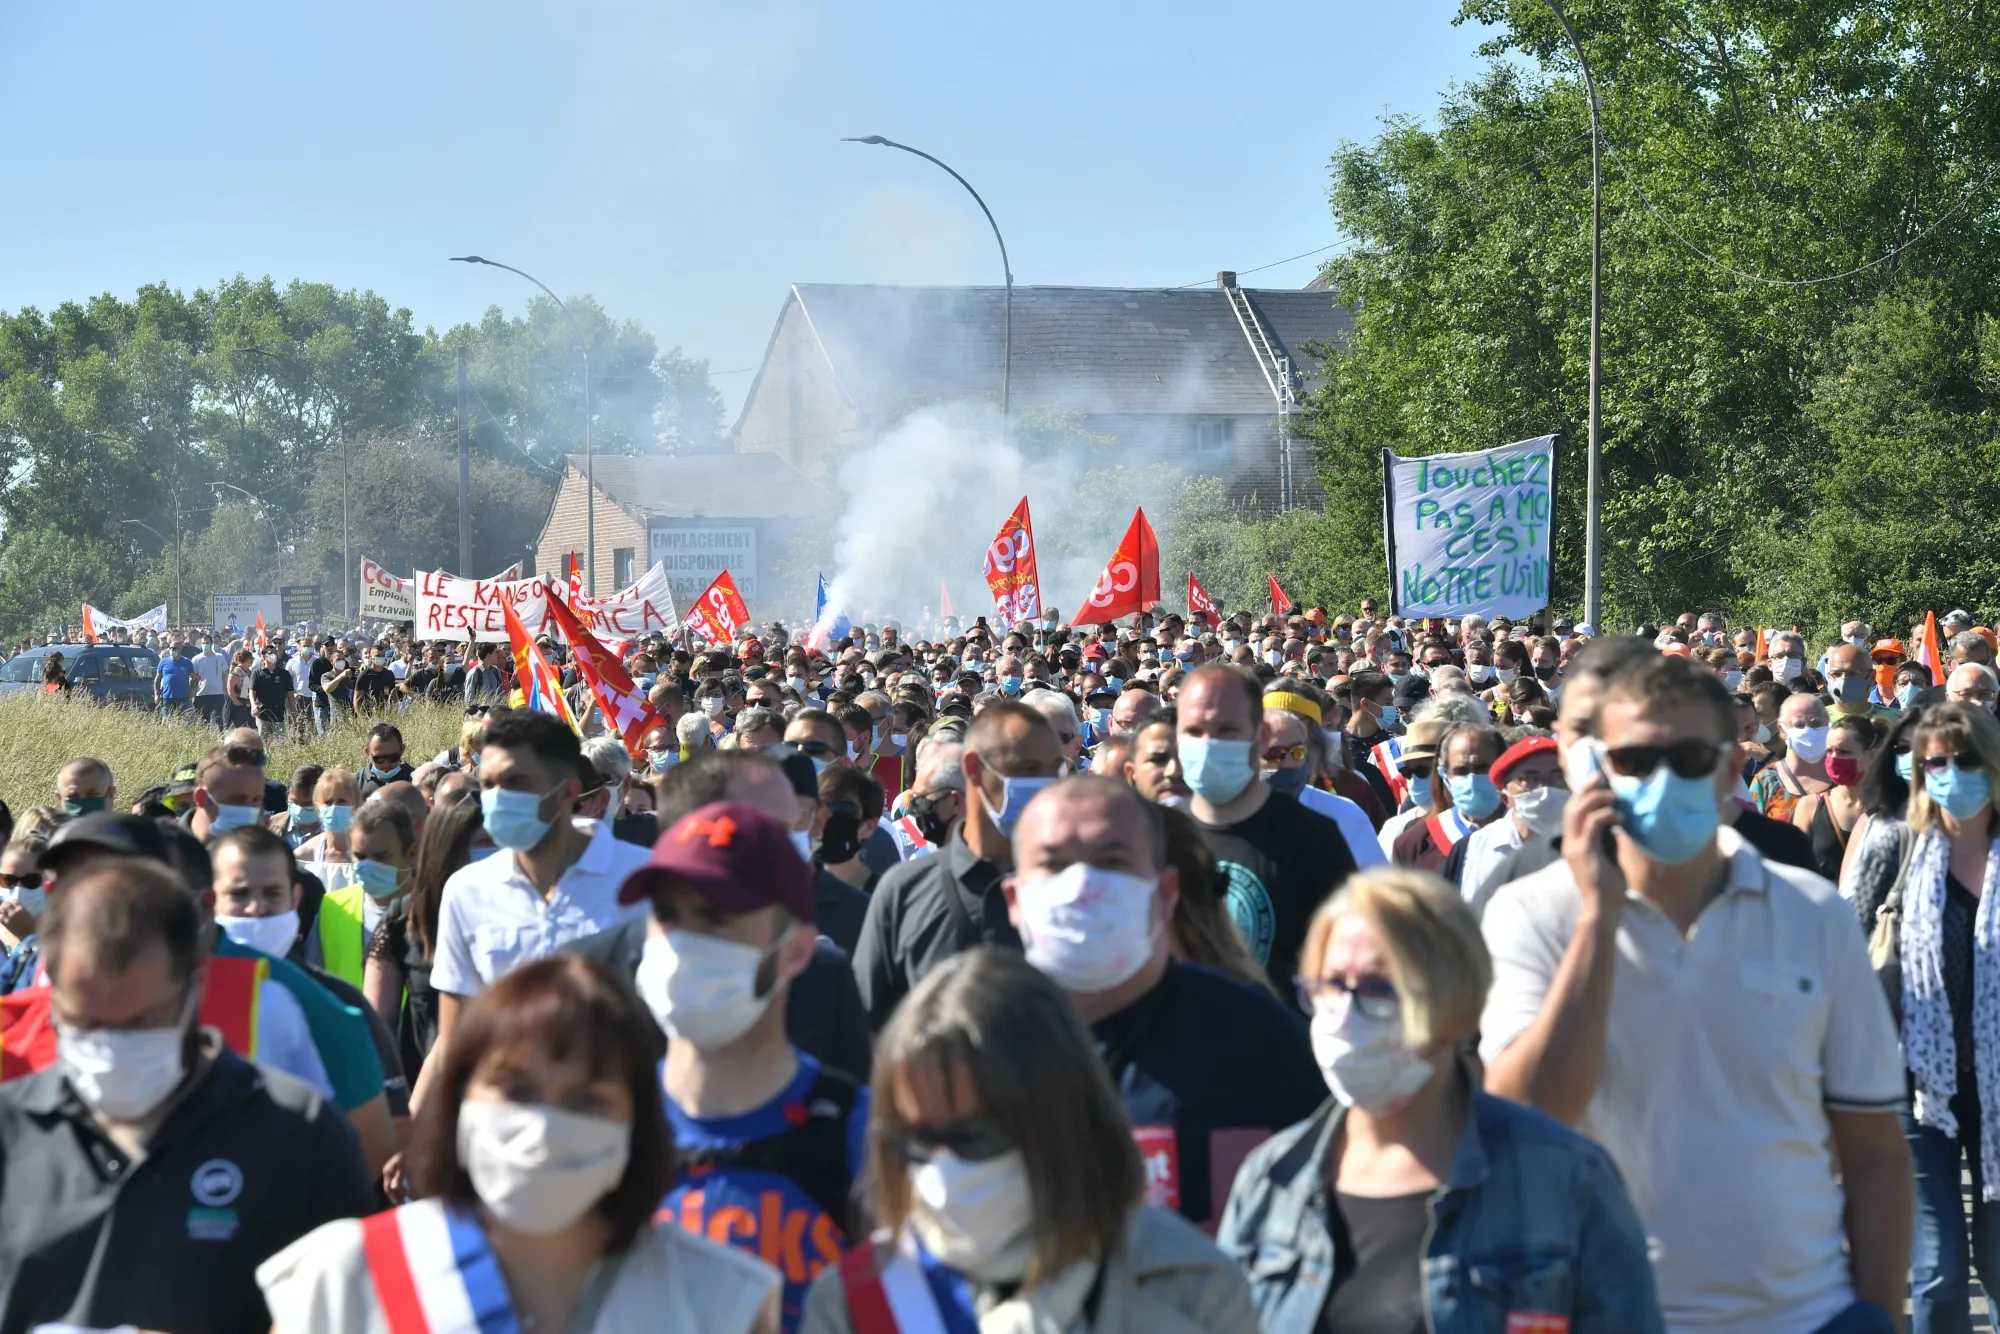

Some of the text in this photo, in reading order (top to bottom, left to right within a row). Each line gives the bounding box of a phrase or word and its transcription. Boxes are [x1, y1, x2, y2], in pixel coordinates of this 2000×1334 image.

[1488, 494, 1506, 522] A
[652, 532, 751, 549] EMPLACEMENT
[664, 554, 744, 571] DISPONIBLE
[363, 562, 407, 593] CGT
[421, 573, 453, 599] LE
[589, 600, 667, 634] MCA
